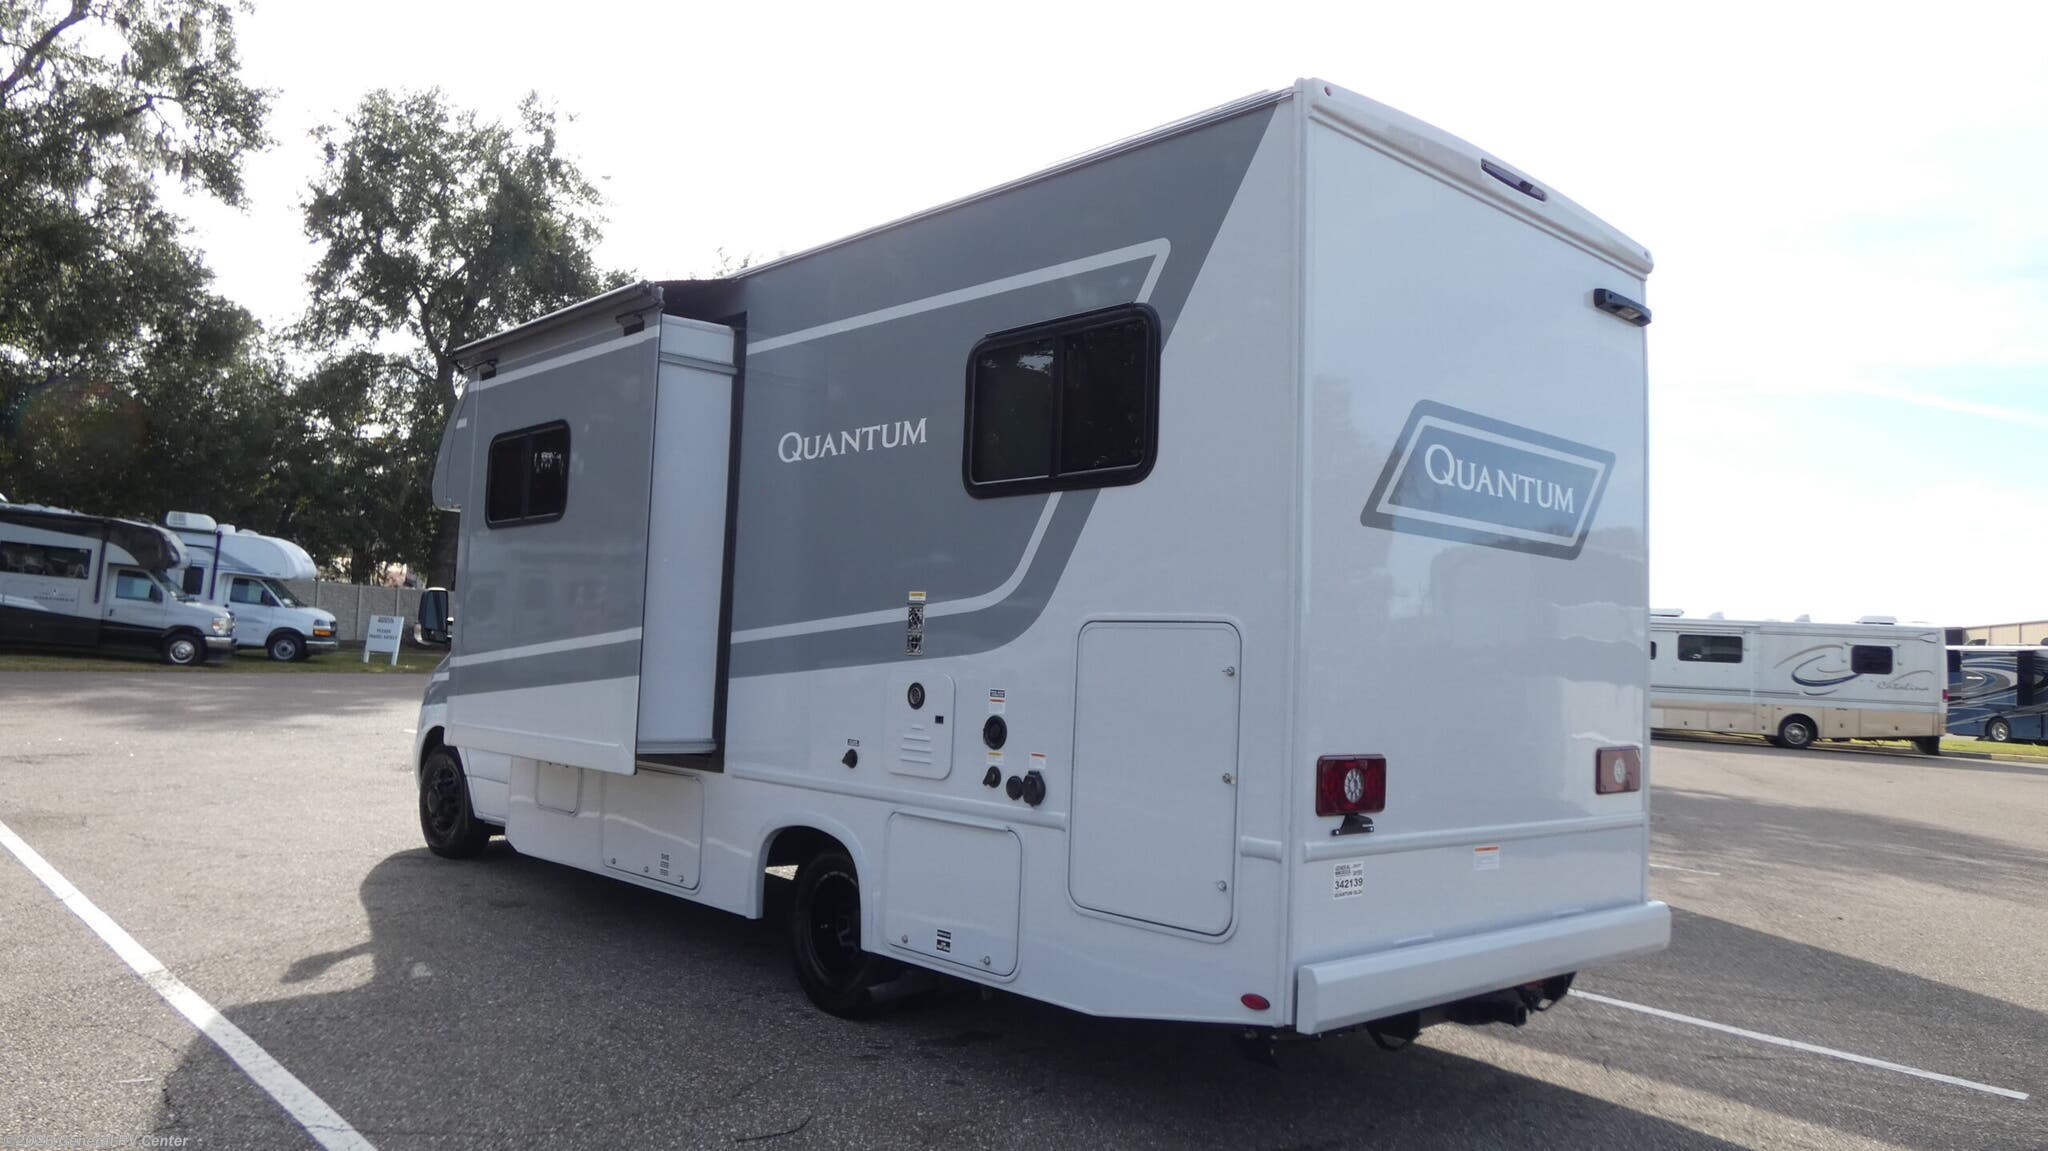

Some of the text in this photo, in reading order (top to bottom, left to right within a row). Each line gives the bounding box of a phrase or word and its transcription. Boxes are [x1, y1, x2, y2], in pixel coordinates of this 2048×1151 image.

[778, 417, 928, 463] QUANTUM
[1424, 443, 1576, 514] QUANTUM
[1334, 877, 1363, 890] 342139
